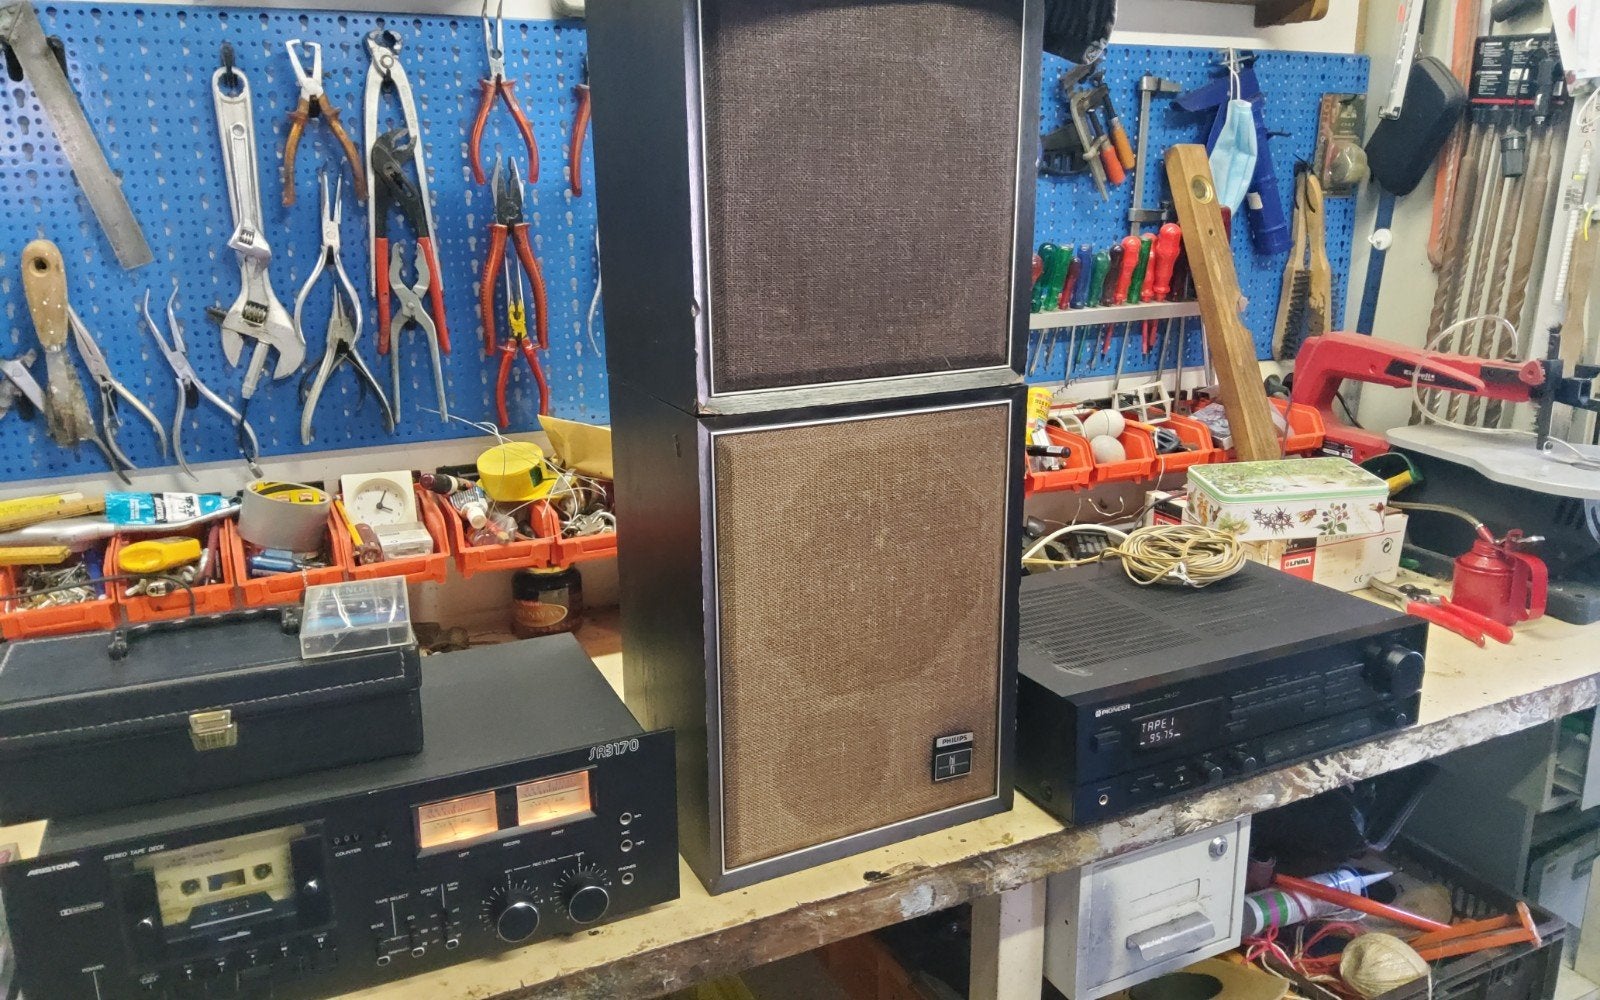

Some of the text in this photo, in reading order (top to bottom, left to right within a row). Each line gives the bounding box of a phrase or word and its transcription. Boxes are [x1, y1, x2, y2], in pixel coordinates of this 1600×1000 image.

[1101, 703, 1131, 716] PIONEER
[1141, 718, 1167, 733] TAPE
[942, 735, 968, 745] PHILIPS
[588, 738, 640, 761] SR3170
[103, 844, 165, 861] STEREO TAPE DECK
[335, 848, 362, 857] COUNTER
[389, 893, 409, 902] SELECT
